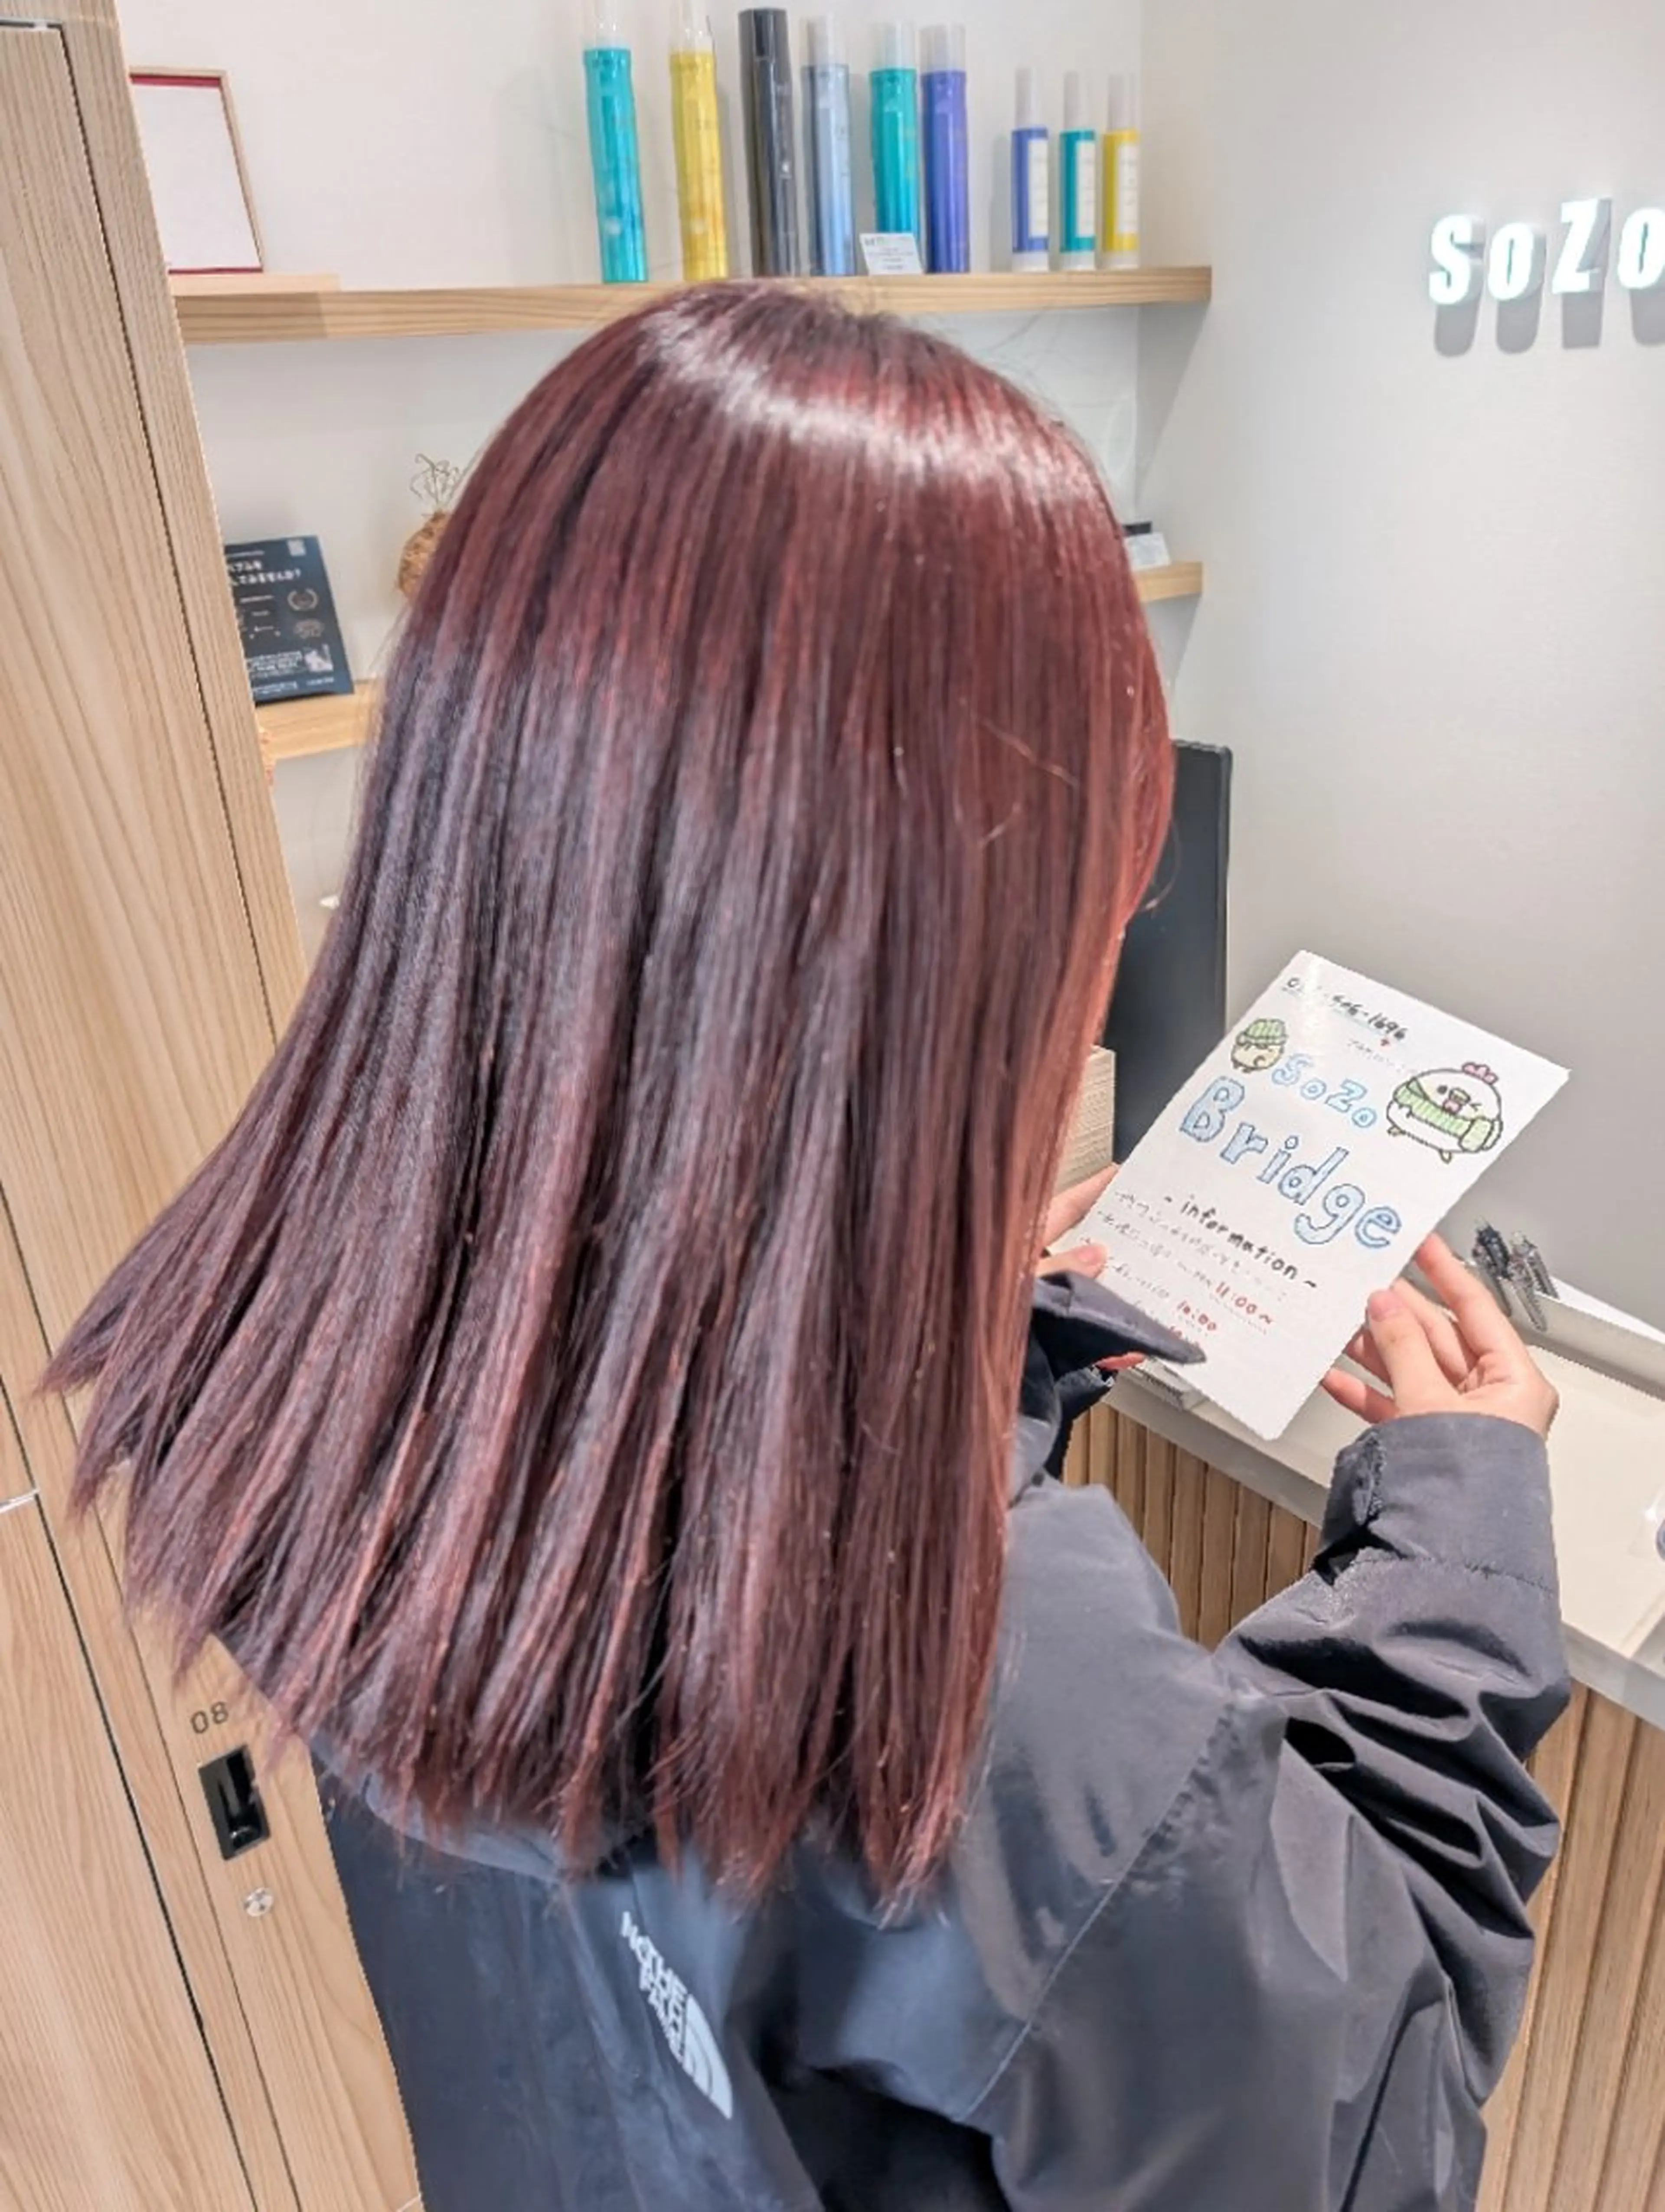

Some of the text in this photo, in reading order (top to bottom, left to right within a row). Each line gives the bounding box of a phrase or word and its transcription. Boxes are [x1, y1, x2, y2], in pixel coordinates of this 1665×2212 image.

[1179, 1075, 1402, 1248] Bridge
[1179, 1193, 1299, 1281] information
[190, 1701, 229, 1734] 08
